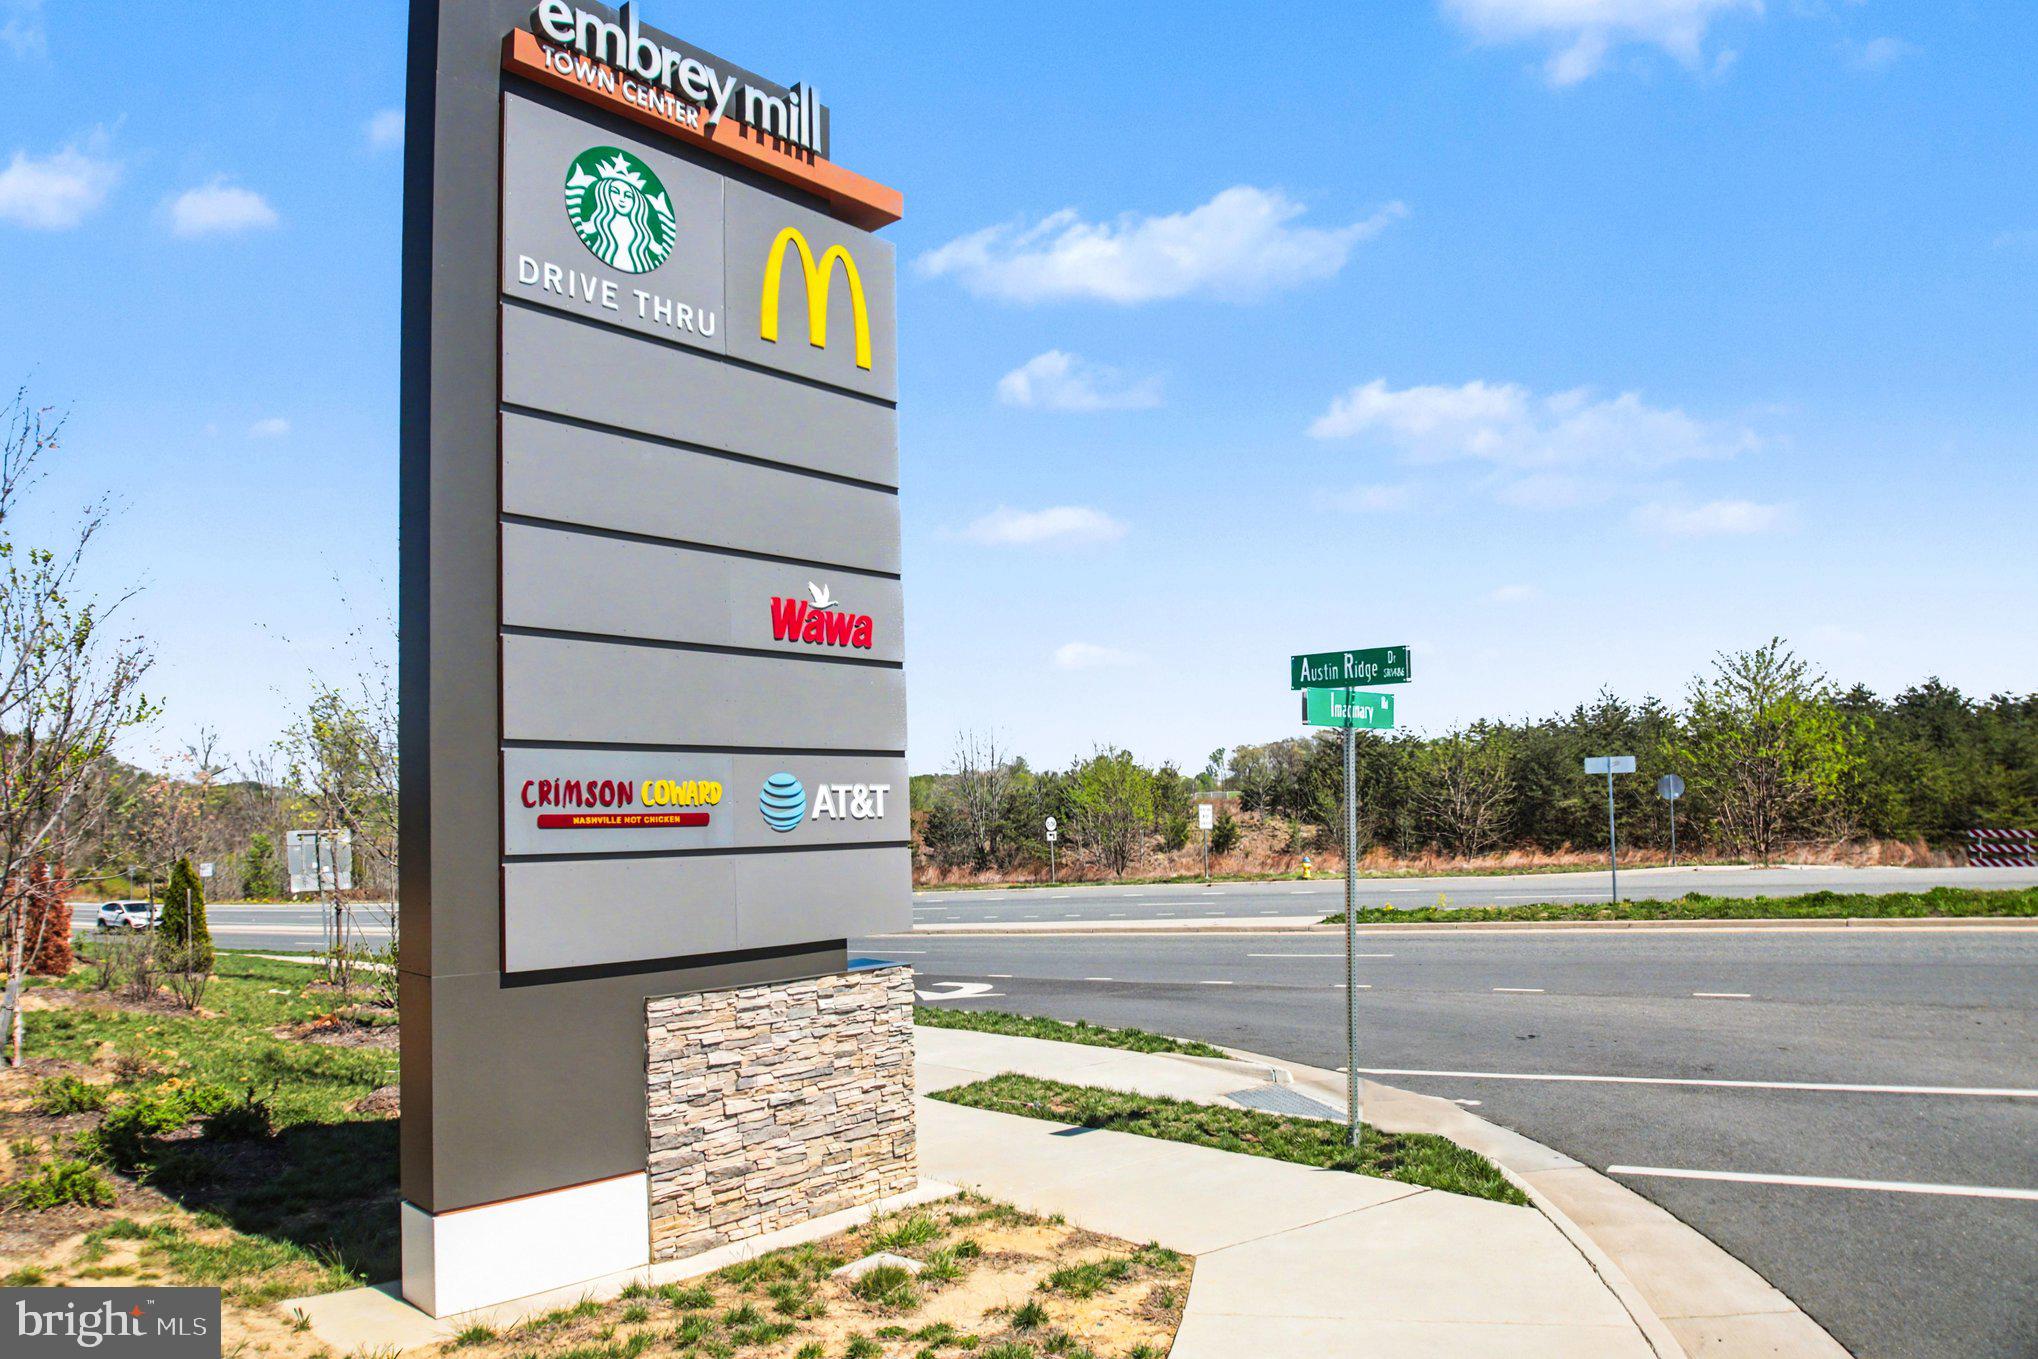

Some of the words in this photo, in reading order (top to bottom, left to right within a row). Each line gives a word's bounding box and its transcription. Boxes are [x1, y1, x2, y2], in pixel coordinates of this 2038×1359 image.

[533, 0, 737, 125] embrey
[742, 82, 821, 154] mill
[542, 44, 616, 94] TOWN
[622, 79, 699, 129] CENTER
[518, 254, 619, 312] DRIVE
[633, 289, 717, 338] THRU
[770, 596, 874, 649] Wawa
[1300, 657, 1339, 682] Austin
[1344, 652, 1378, 682] Ridge
[1387, 650, 1397, 664] Dr
[640, 779, 723, 807] COWARD
[812, 783, 891, 820] AT&T
[573, 816, 622, 825] NASHVILLE
[644, 815, 681, 824] CHICKEN
